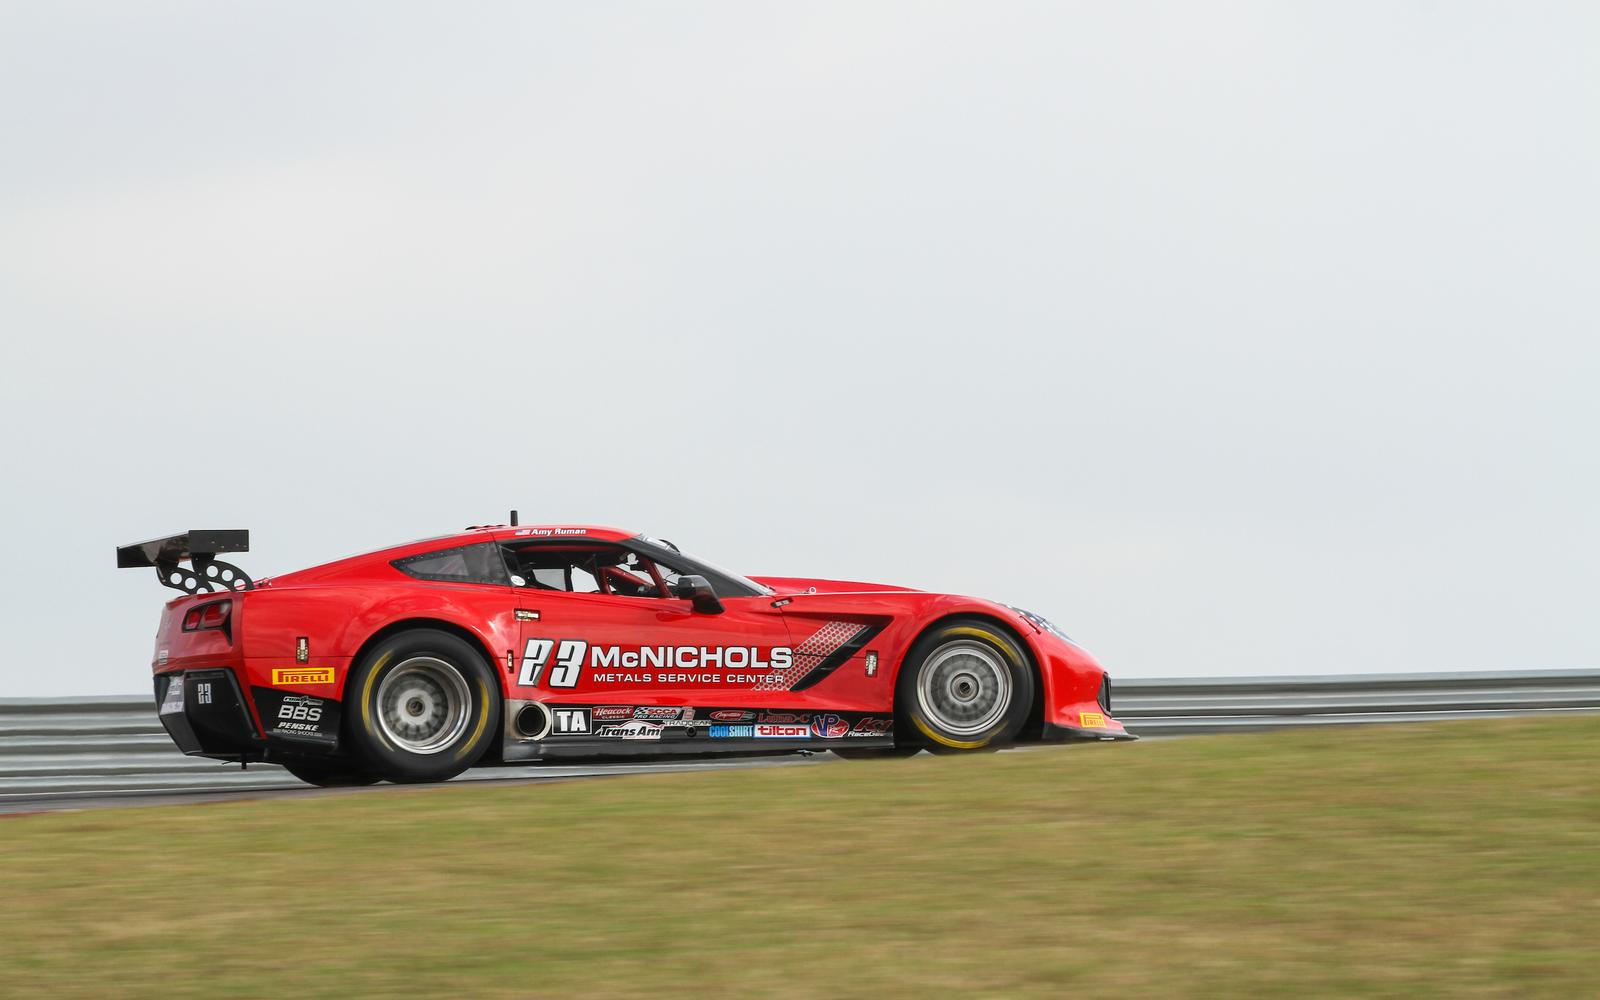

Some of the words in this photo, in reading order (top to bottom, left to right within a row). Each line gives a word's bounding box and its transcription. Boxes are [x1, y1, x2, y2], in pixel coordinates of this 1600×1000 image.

[531, 529, 552, 537] Amy
[518, 638, 588, 688] 23
[591, 646, 793, 669] McNICHOLS
[278, 670, 329, 682] PIRELLI
[593, 673, 652, 682] METALS
[658, 674, 720, 683] SERVICE
[726, 674, 784, 683] CENTER
[198, 683, 212, 704] 23
[278, 705, 322, 721] BBS
[595, 707, 632, 716] Heacock
[278, 721, 319, 731] PENSKE
[556, 711, 587, 732] TA
[814, 713, 839, 738] VP
[601, 726, 636, 736] Trans
[637, 726, 660, 736] Am
[757, 725, 807, 736] tilton
